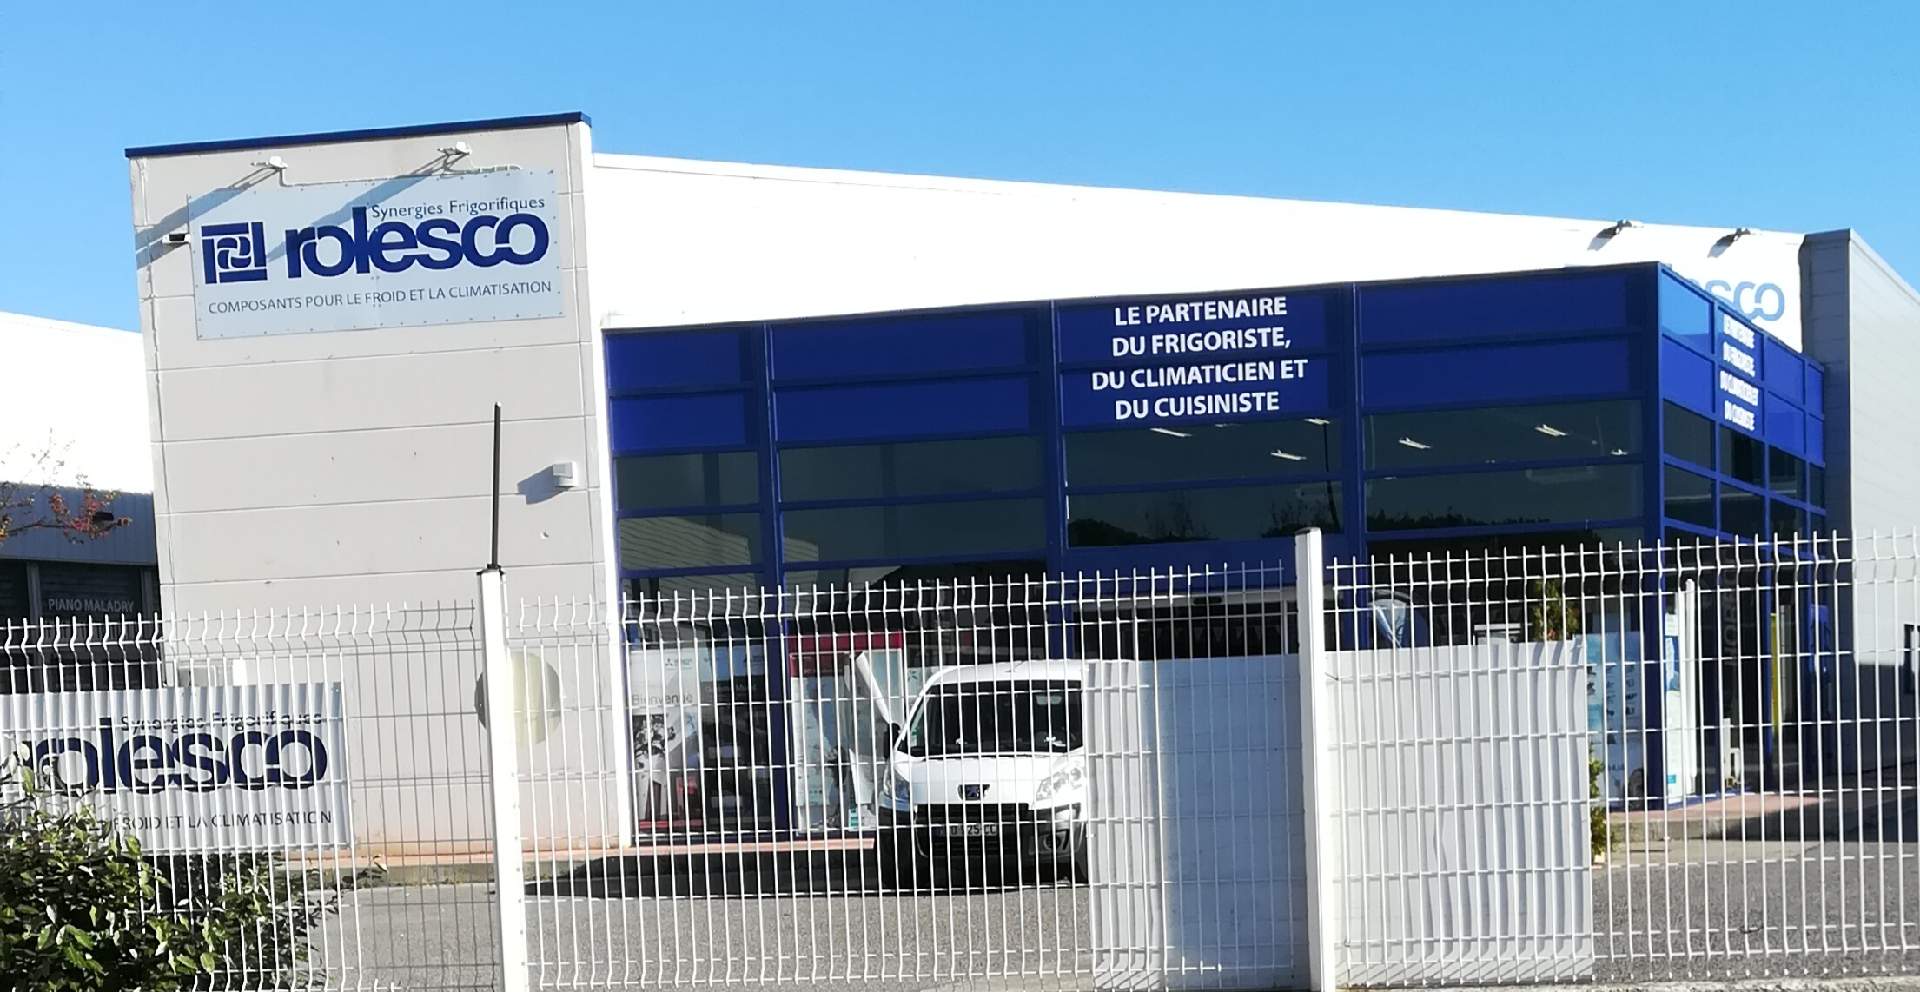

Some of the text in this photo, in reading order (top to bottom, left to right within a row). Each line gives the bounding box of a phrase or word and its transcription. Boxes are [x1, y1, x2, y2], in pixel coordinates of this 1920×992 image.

[371, 196, 546, 221] Synergies Frigorifiques
[285, 206, 550, 279] rolesco
[208, 281, 552, 315] COMPOSANTS POUR LE FROID ET LA CLIMATISATION
[1115, 296, 1288, 326] LE PARTENAIRE
[1112, 326, 1291, 357] DU FRIGORISTE,
[1092, 359, 1309, 390] DU CLIMATICIEN ET
[1115, 391, 1280, 420] DU CUISINISTE
[49, 599, 82, 611] PIANO
[213, 710, 322, 731] Frigorifques
